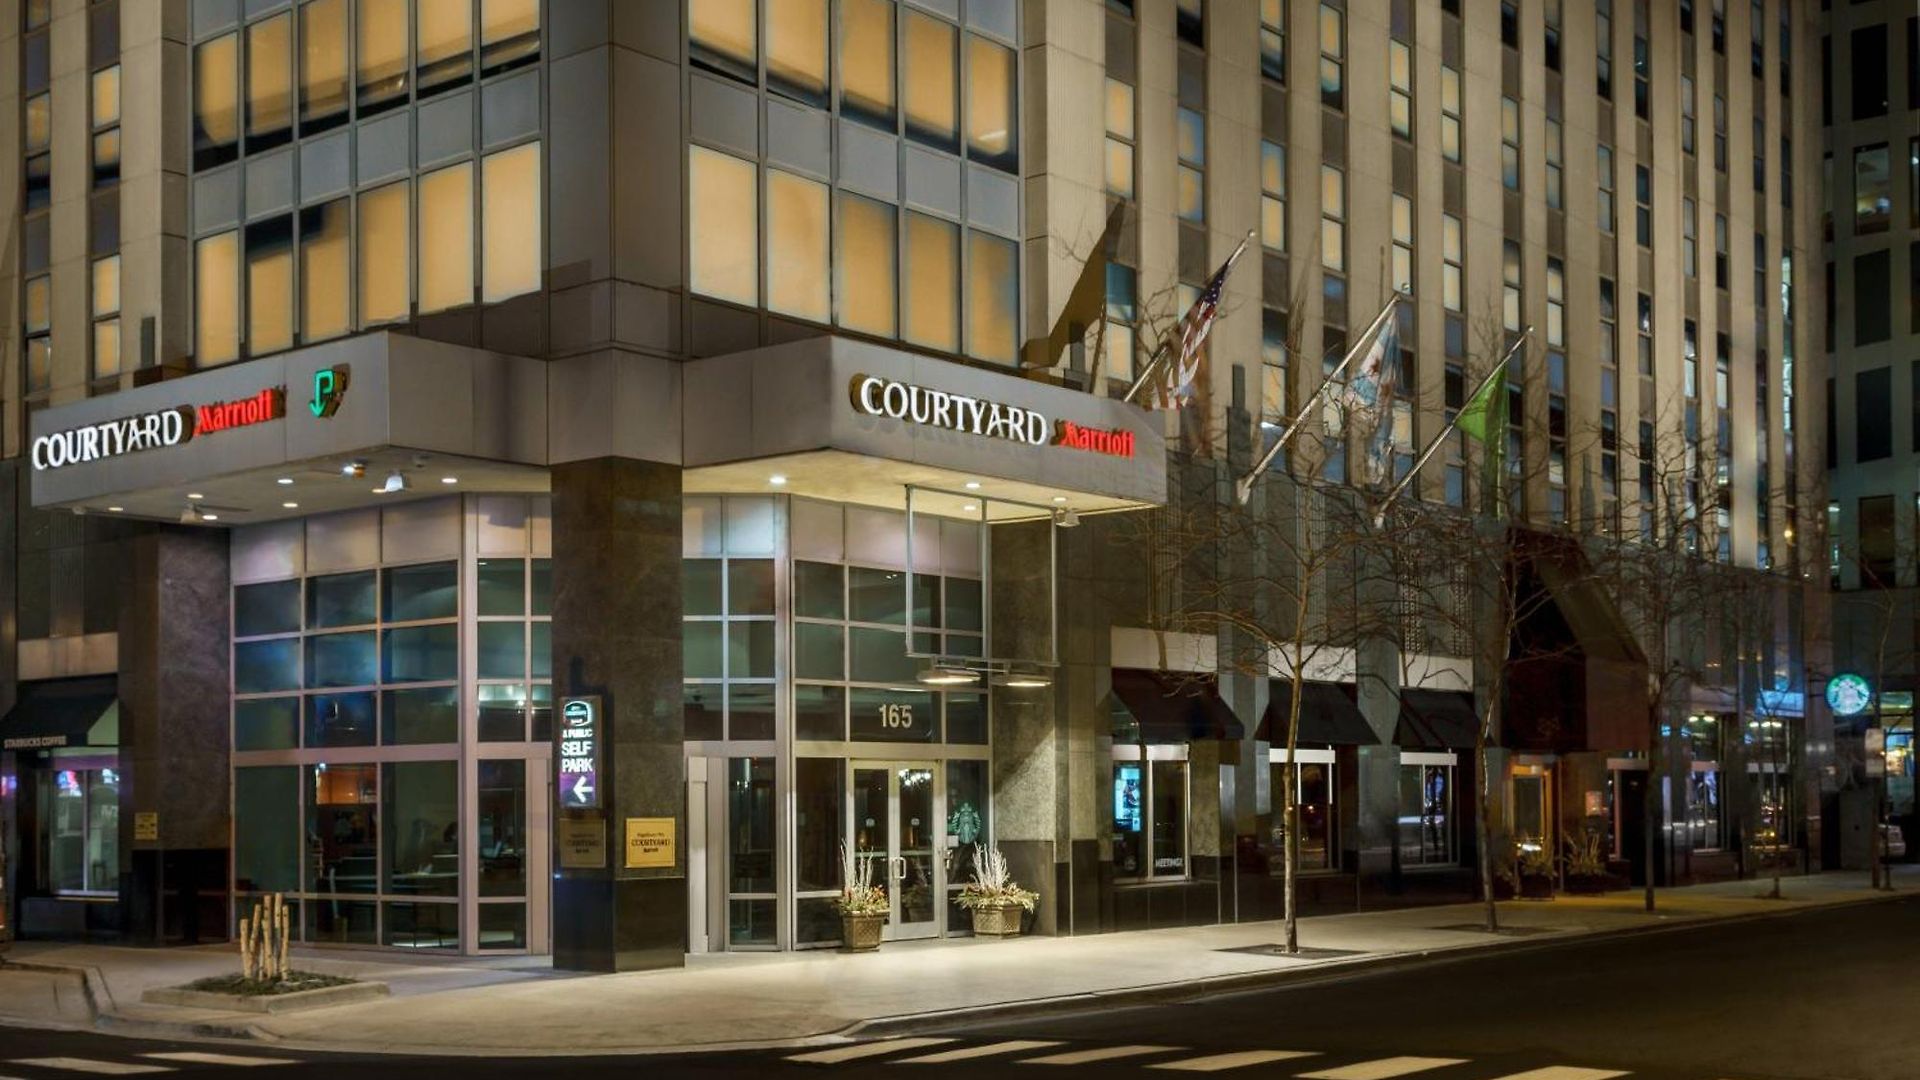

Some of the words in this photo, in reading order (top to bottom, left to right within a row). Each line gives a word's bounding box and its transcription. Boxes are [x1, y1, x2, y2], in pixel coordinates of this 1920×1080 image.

[860, 377, 1048, 445] COURTYARD
[1060, 420, 1135, 461] Marriott
[32, 410, 182, 471] COURTYARD
[194, 388, 273, 438] Marriott
[878, 703, 913, 728] 165
[4, 738, 41, 749] STARBUCKS
[42, 735, 67, 746] COFFEE
[561, 741, 592, 756] SELF
[561, 758, 593, 773] PARK
